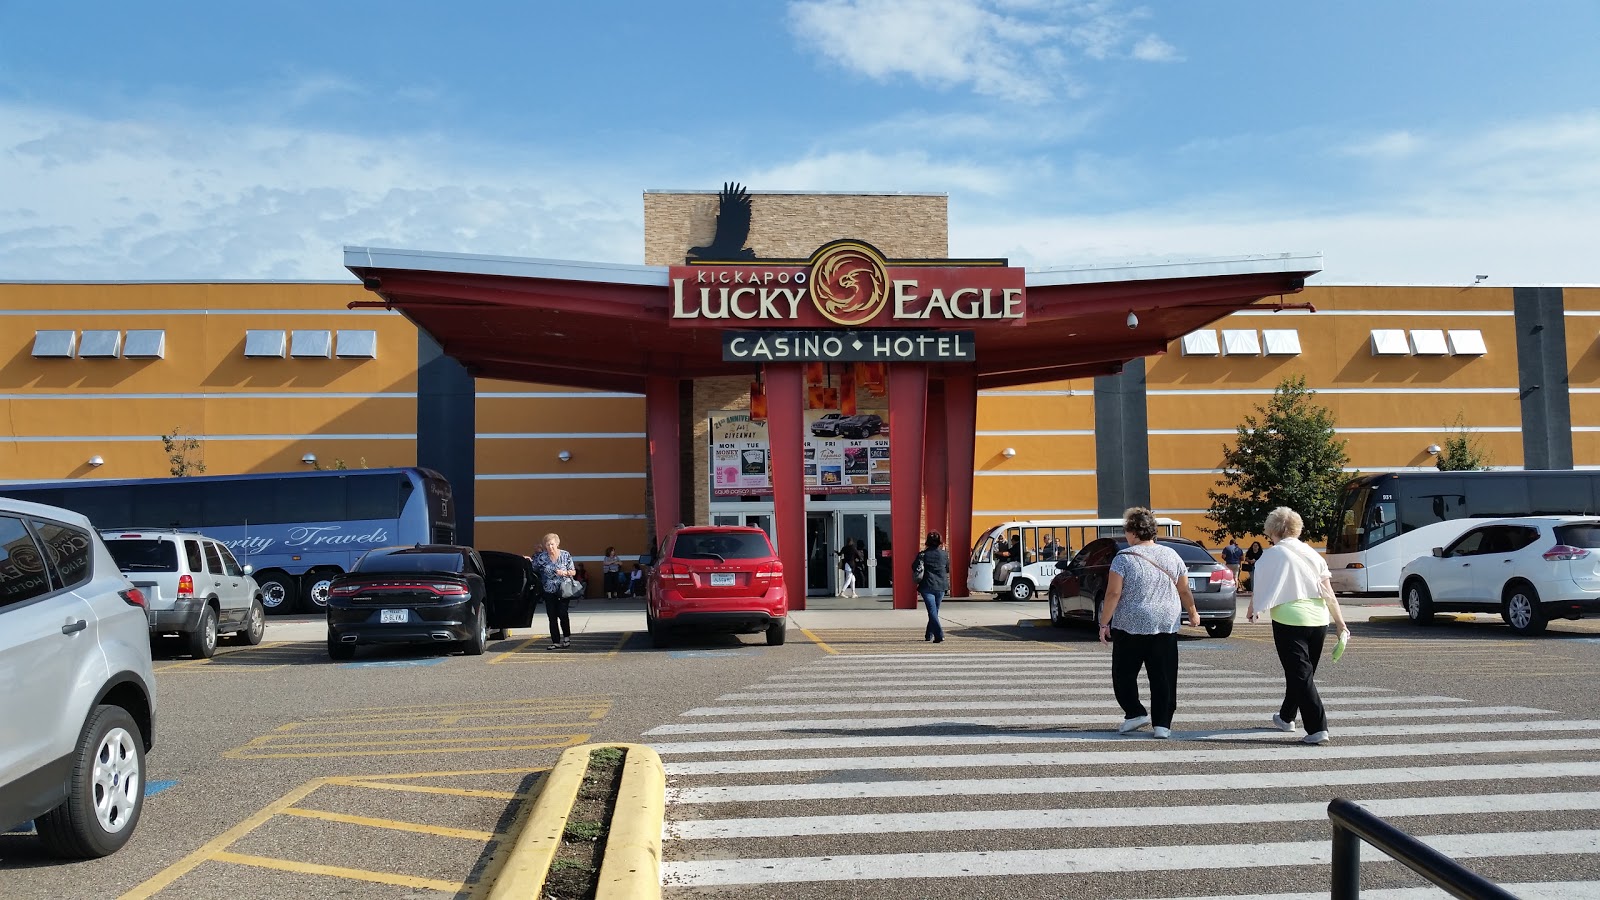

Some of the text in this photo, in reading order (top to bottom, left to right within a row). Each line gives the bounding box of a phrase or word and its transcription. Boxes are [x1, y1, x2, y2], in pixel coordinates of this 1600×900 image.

[698, 270, 806, 285] KICKAPOO
[672, 278, 1024, 319] LUCKY EAGLE
[730, 334, 966, 360] CASINO HOTEL
[284, 525, 388, 546] Travels
